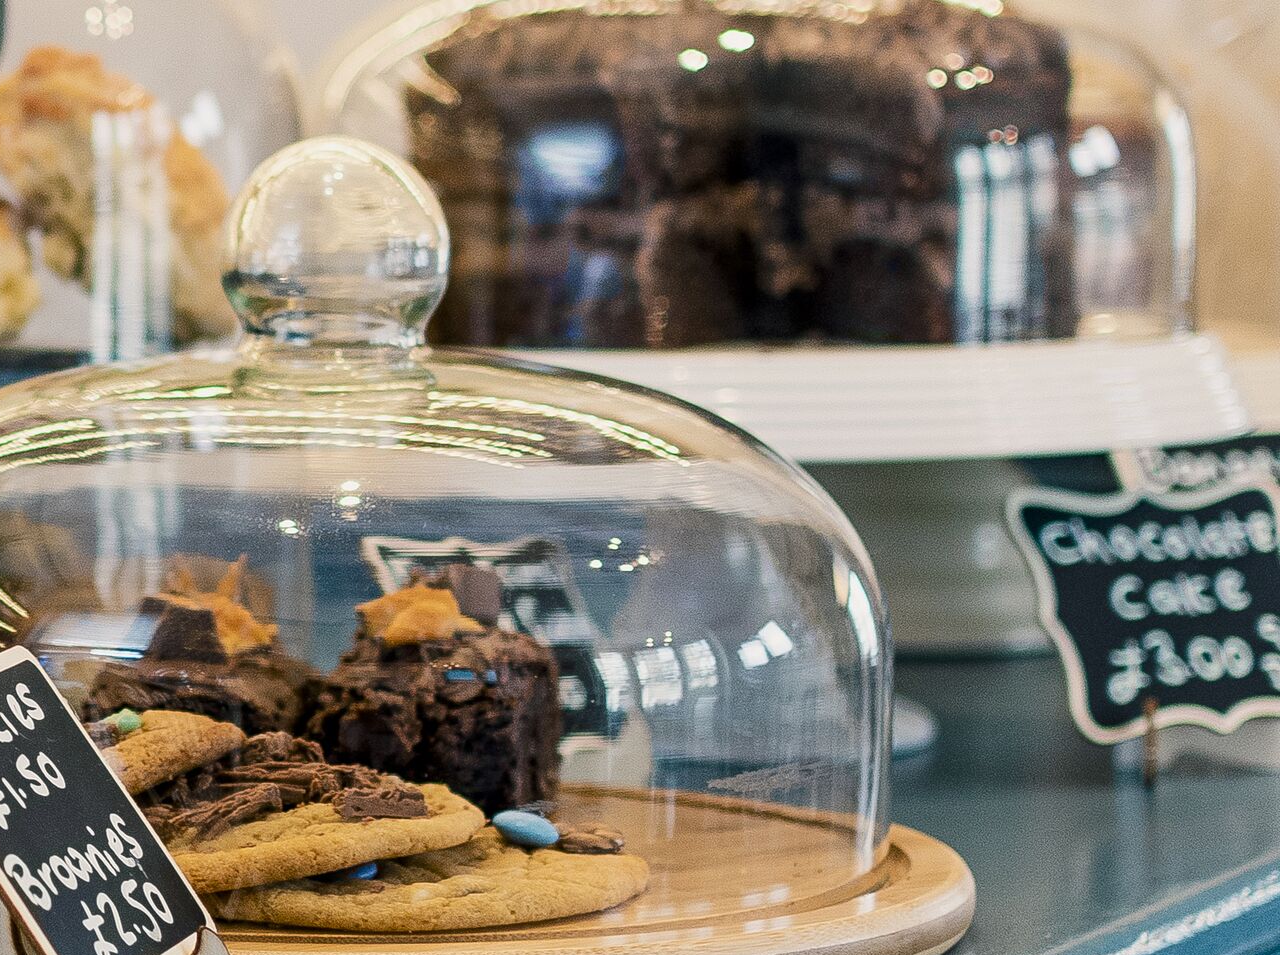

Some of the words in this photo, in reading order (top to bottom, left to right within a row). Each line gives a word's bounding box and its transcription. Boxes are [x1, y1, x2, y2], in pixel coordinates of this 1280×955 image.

[1038, 510, 1276, 565] Chocolate
[1109, 567, 1253, 621] Cake
[3, 812, 144, 912] Brownies
